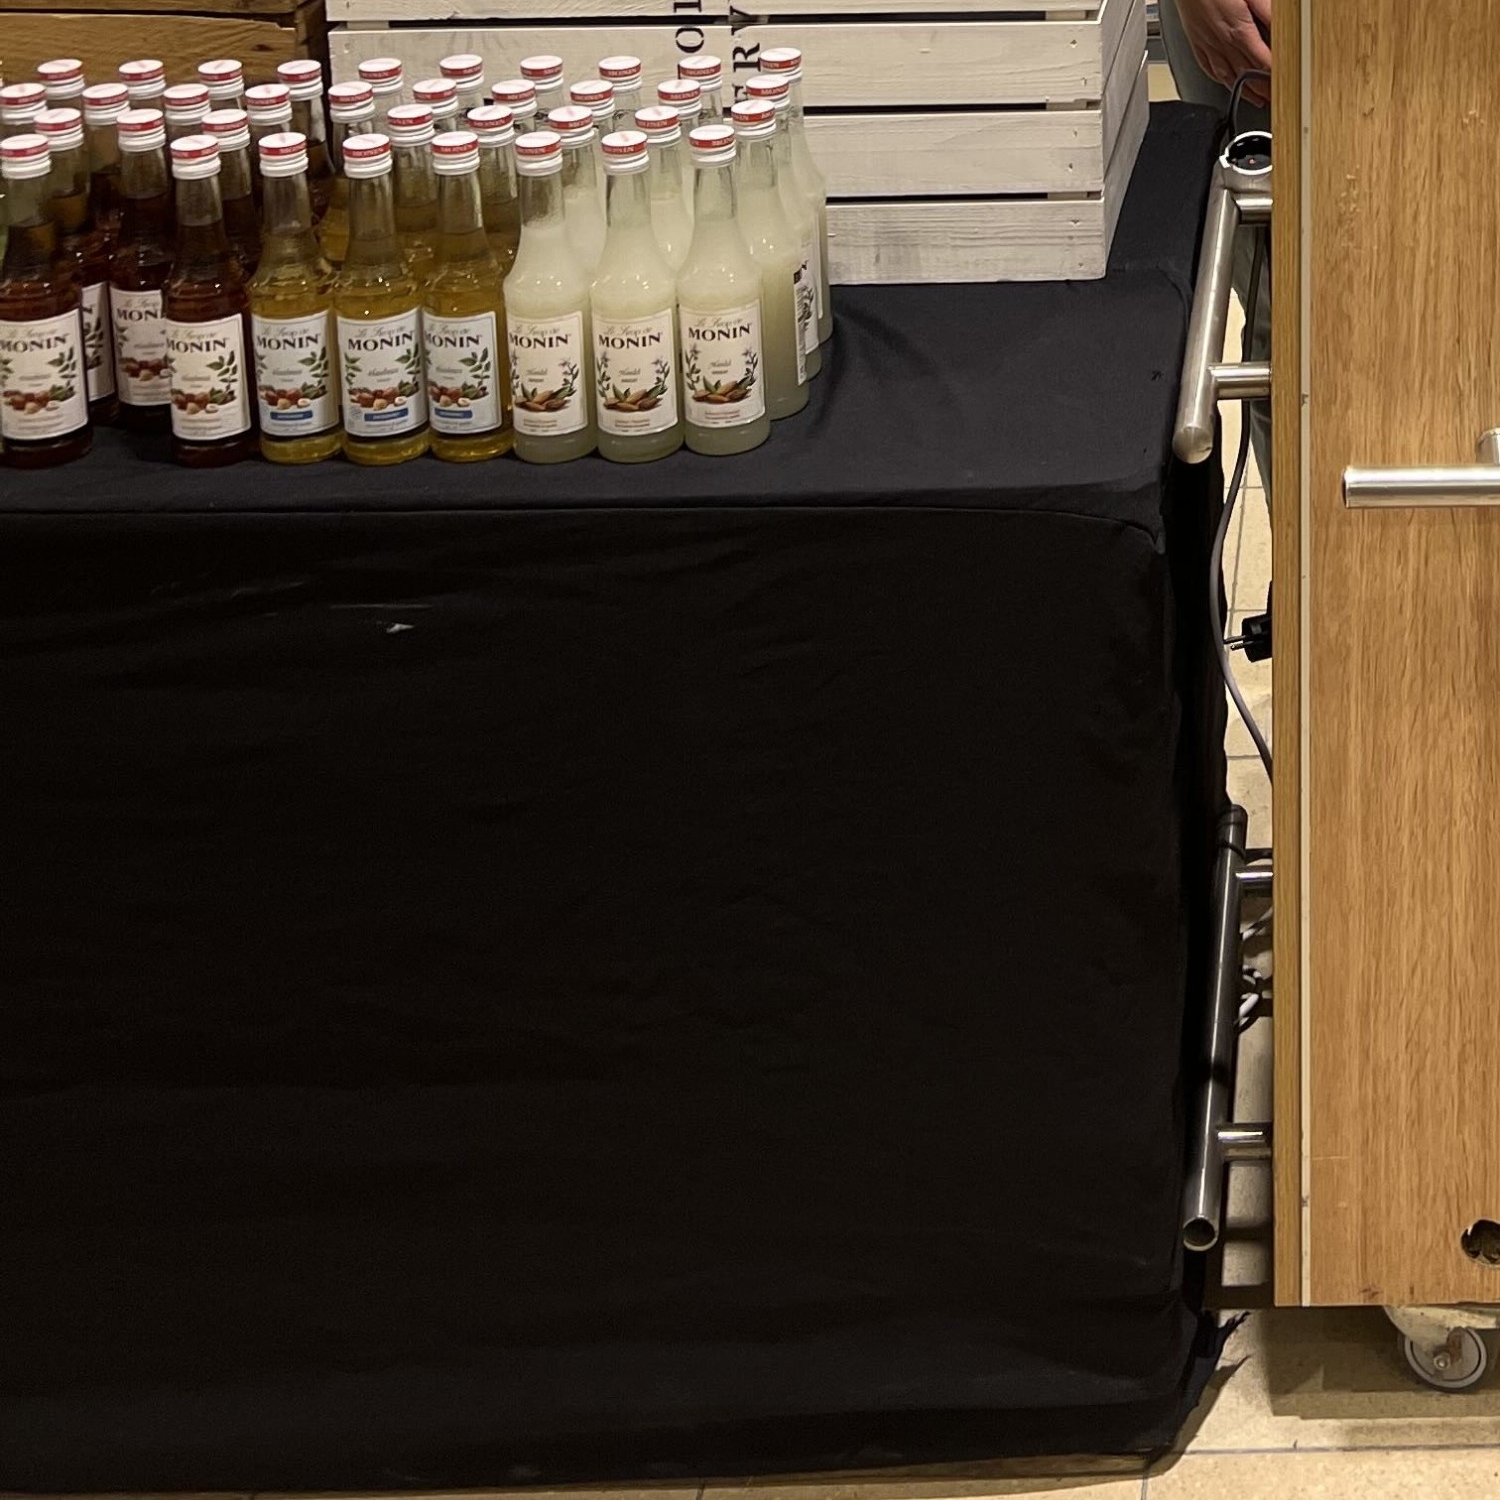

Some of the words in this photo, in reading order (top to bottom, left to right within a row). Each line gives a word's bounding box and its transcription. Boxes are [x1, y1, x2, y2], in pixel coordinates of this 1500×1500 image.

[689, 324, 752, 342] MONIN
[257, 334, 320, 350] MONIN
[348, 332, 414, 351] MONIN
[510, 334, 570, 349] MONIN
[599, 334, 662, 350] MONIN
